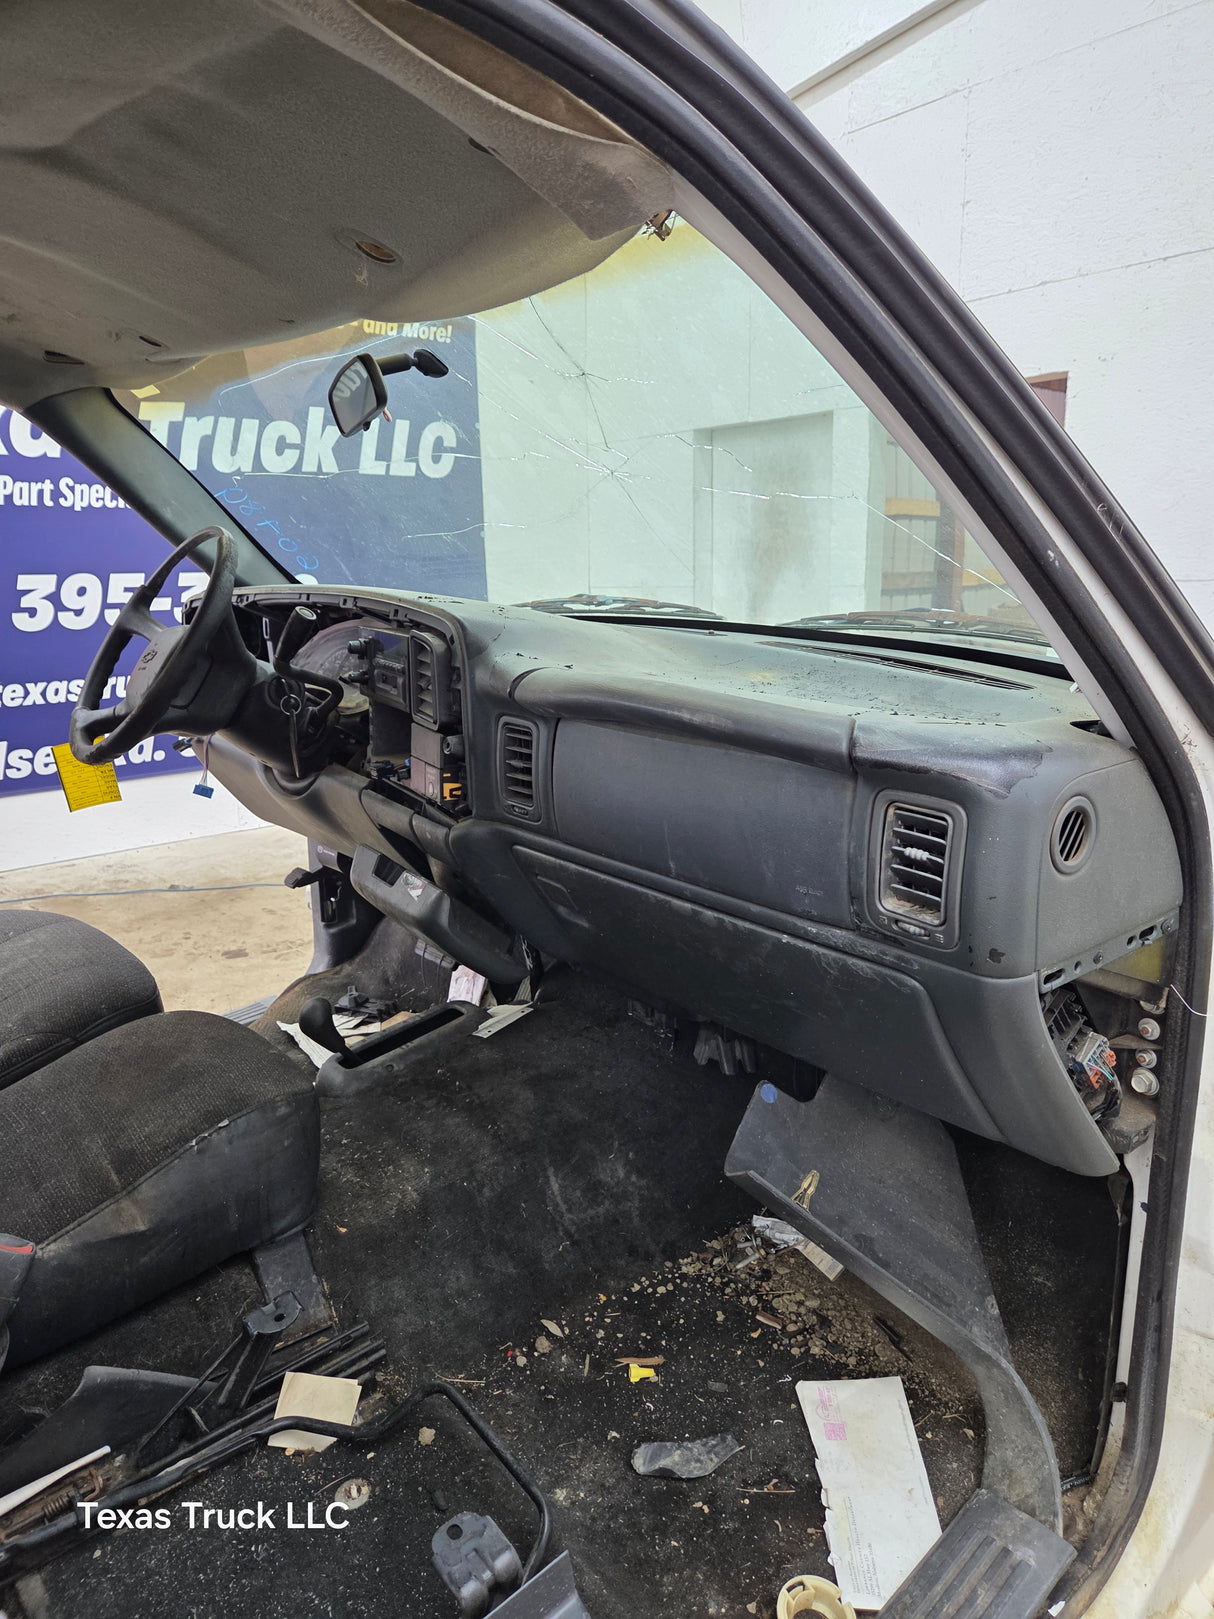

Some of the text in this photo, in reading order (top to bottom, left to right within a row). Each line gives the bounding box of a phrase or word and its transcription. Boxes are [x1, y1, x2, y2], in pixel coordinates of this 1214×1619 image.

[402, 321, 452, 344] More!
[138, 401, 343, 474] Truck
[358, 418, 457, 478] LLC
[0, 475, 54, 507] Part
